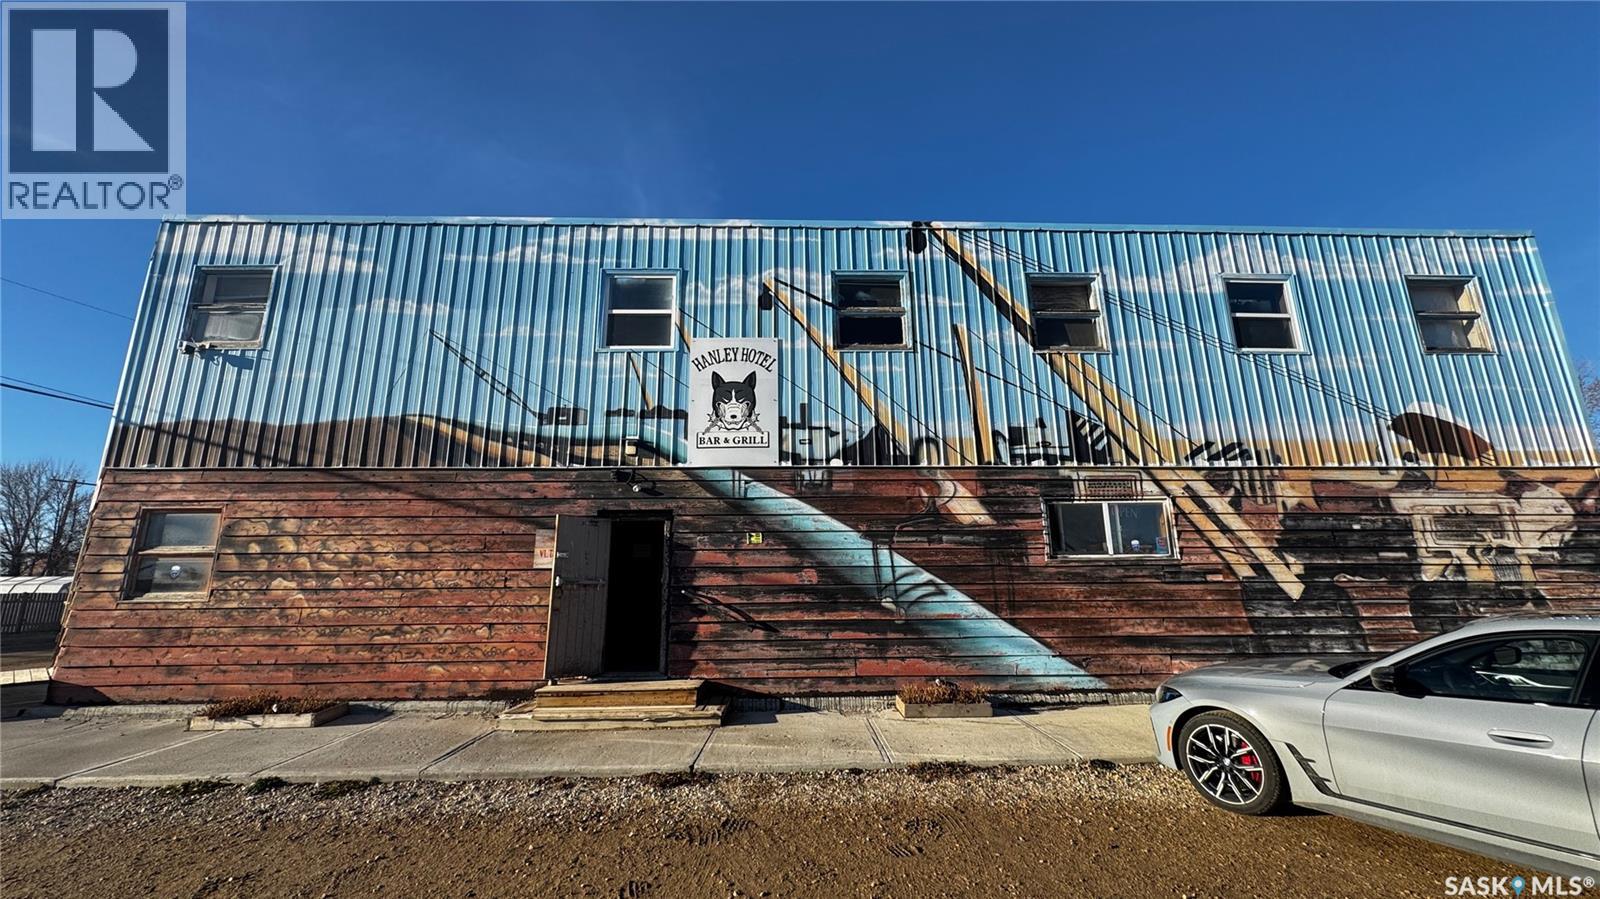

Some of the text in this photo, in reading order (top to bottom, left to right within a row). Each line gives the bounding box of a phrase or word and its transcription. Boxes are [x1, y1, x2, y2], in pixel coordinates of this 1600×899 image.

[691, 346, 777, 373] HANLEY HOTEL
[698, 436, 768, 445] BAR & GRILL
